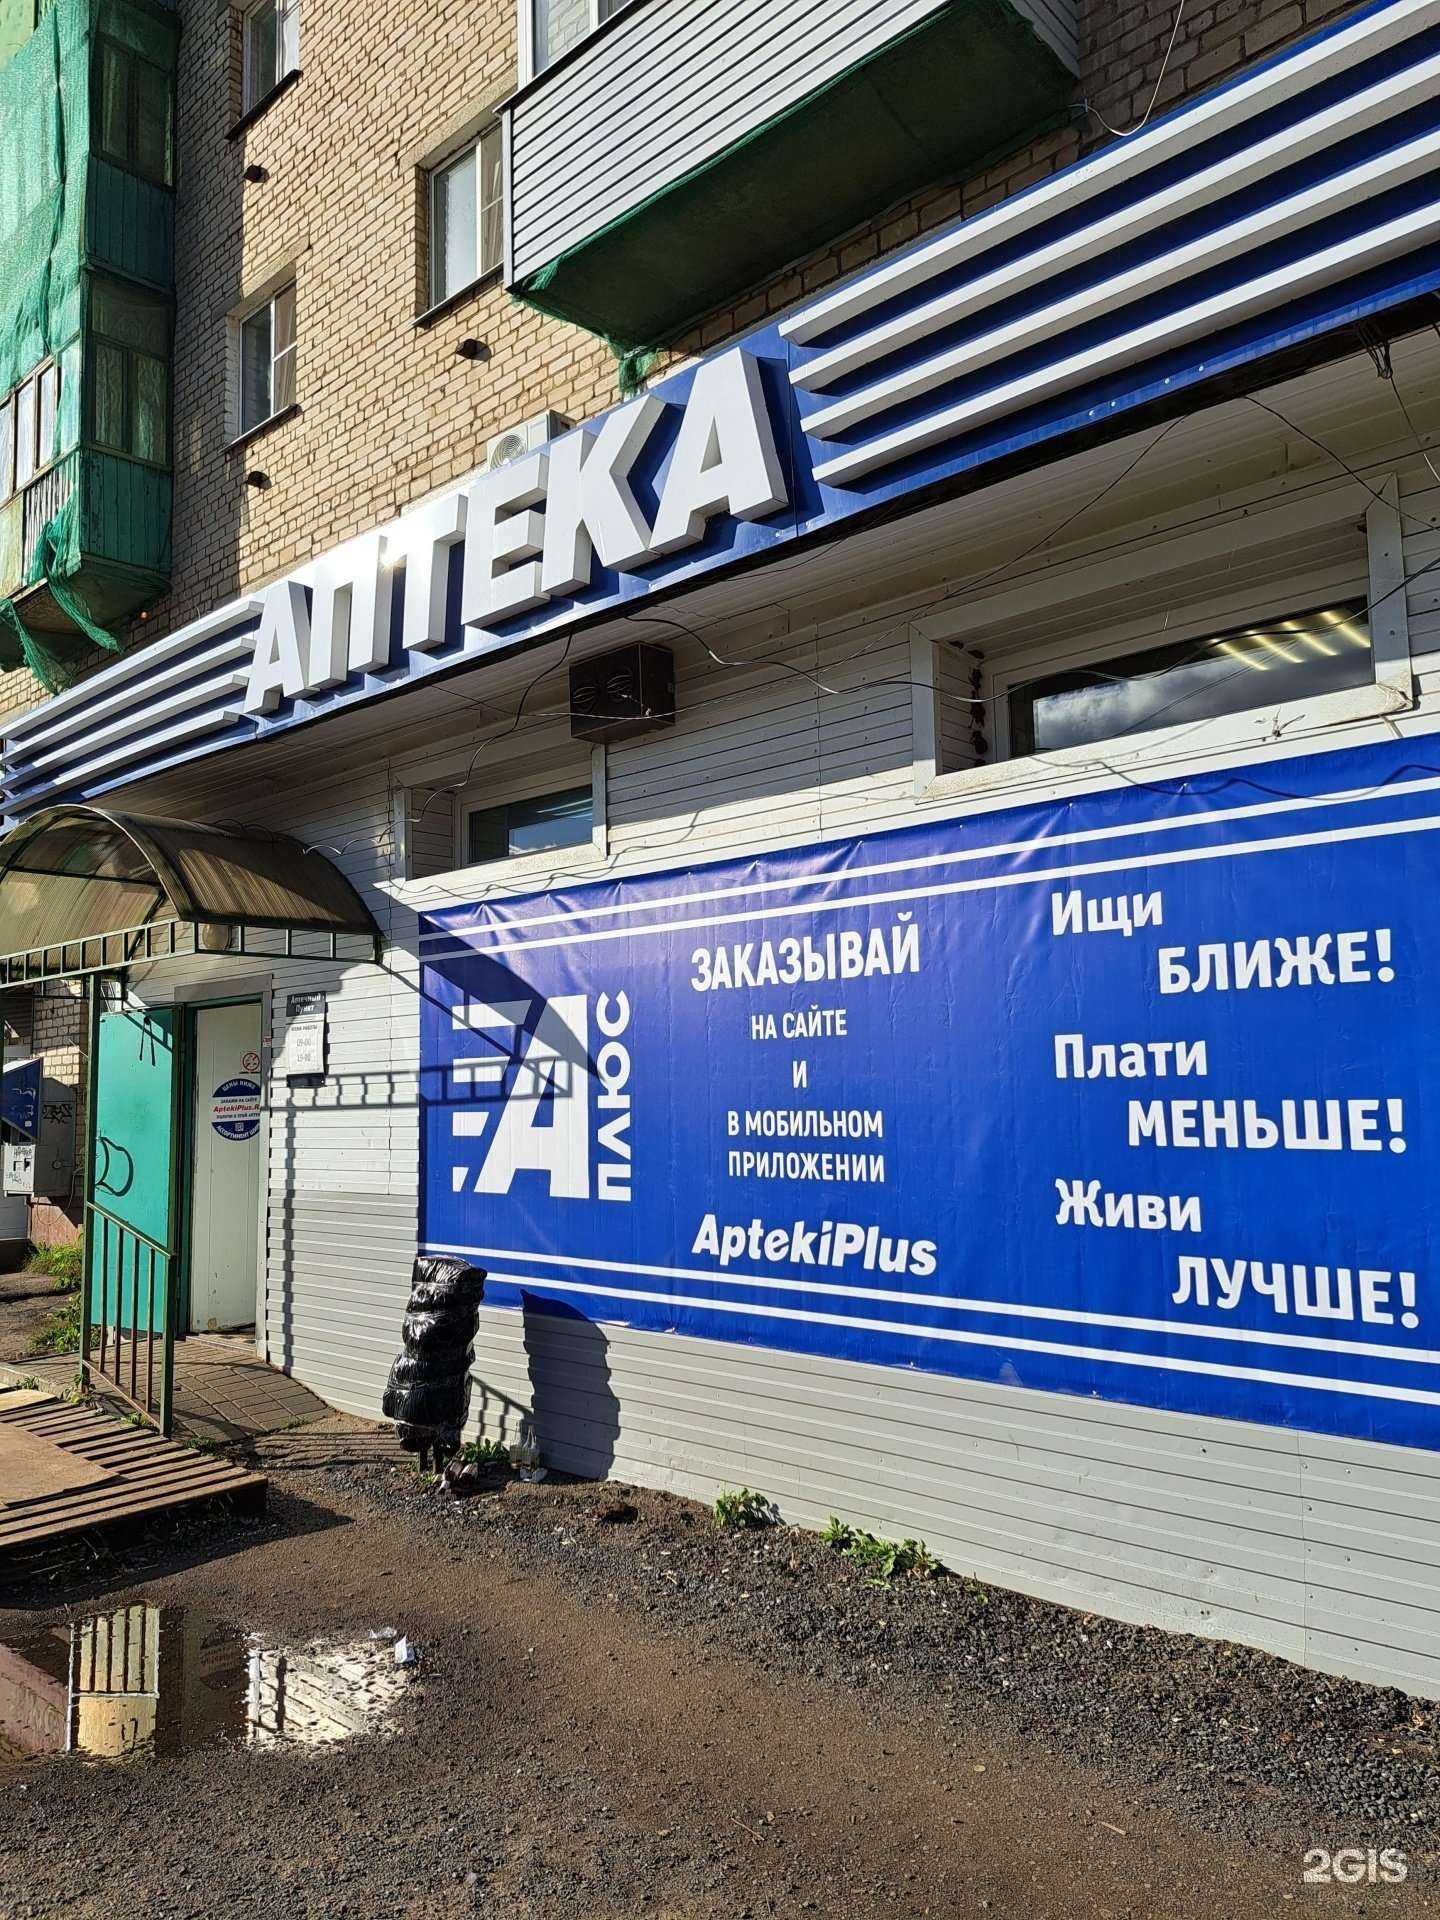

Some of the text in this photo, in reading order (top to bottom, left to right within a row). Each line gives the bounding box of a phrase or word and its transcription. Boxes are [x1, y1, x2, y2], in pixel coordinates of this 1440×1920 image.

[243, 346, 788, 716] АПТЕКА
[1051, 889, 1163, 936] Ищи
[691, 912, 920, 992] ЗАКАЗЫВАЙ
[1158, 928, 1395, 994] БЛИЖЕ!
[751, 1004, 848, 1040] НА САЙТЕ
[792, 1060, 808, 1089] И
[1054, 1033, 1208, 1079] Плати
[596, 990, 632, 1202] ПЛЮС
[727, 1110, 883, 1138] В МОБИЛЬНОМ
[1128, 1098, 1407, 1154] МЕНЬШЕ!
[728, 1150, 885, 1183] ПРИЛОЖЕНИИ
[1054, 1178, 1202, 1232] Живи
[692, 1213, 937, 1277] AptekiPlus
[1172, 1255, 1419, 1329] ЛУЧШЕ!
